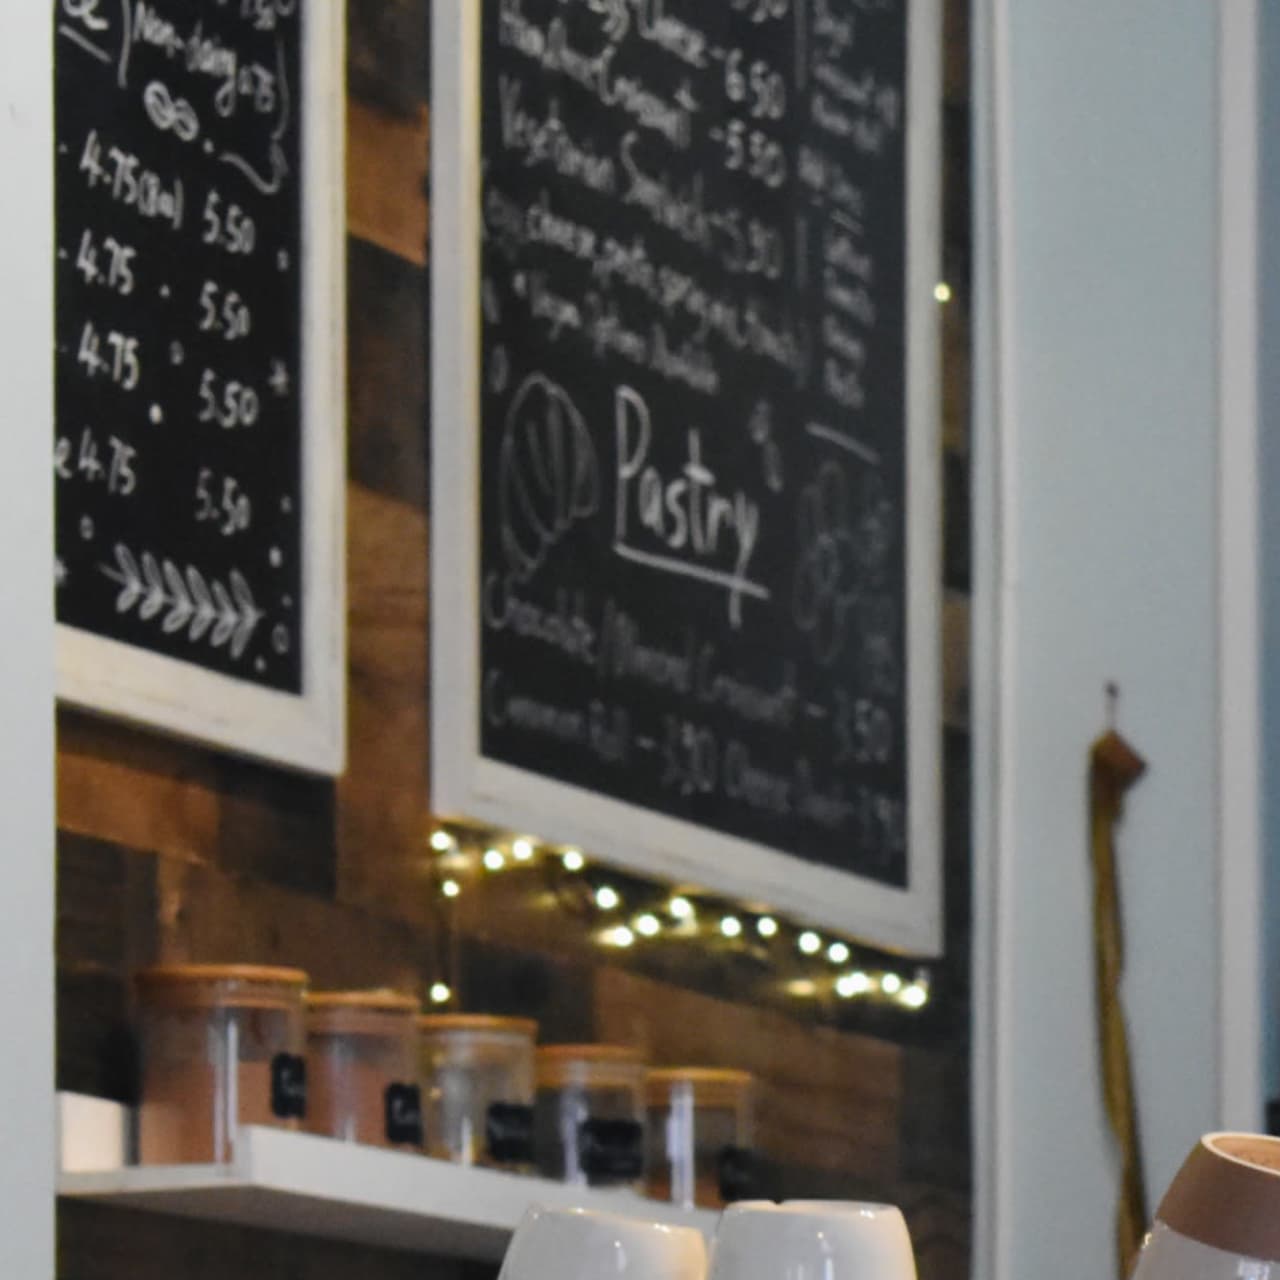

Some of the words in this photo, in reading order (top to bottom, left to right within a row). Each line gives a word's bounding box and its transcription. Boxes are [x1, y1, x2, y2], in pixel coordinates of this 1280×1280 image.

[77, 229, 136, 295] 4.75
[199, 280, 250, 340] 5.50
[77, 320, 140, 390] 4.75
[198, 366, 259, 428] 5.50
[78, 427, 137, 496] 4.75
[195, 468, 251, 535] 5.50
[615, 385, 760, 629] Pastry
